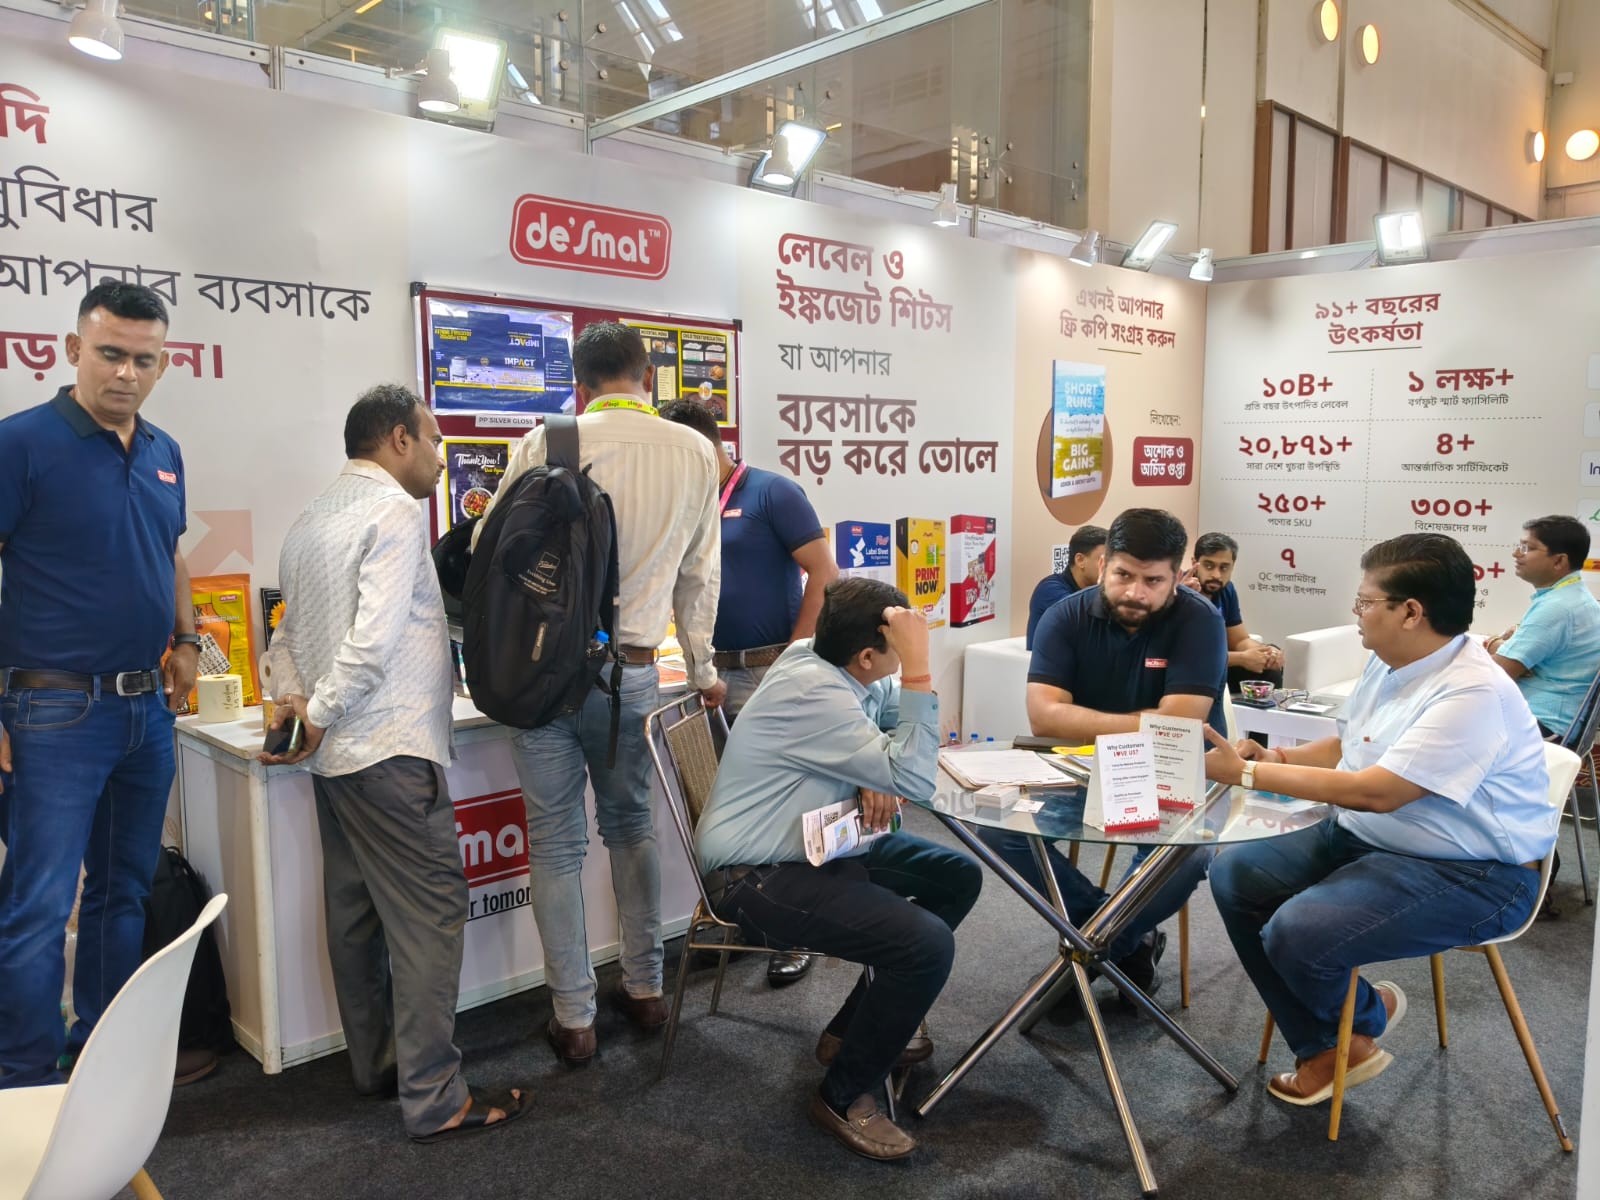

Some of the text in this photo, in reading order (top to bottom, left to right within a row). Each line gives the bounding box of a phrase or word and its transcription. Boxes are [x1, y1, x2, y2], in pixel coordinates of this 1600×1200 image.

[778, 233, 904, 279] লেবেল ও
[194, 273, 371, 321] ব্যবসাকে
[777, 269, 953, 333] ইঙ্কজেট শিটস
[1076, 286, 1164, 320] এখনই আপনার
[1315, 293, 1441, 319] ৯১+ বছরের
[1060, 309, 1176, 348] ফ্রি কপি সংগ্রহ করুন
[1327, 318, 1424, 344] উৎকর্ষতা
[504, 357, 536, 367] IMPACT
[778, 343, 892, 376] যা আপনার
[1064, 382, 1098, 396] SHORT
[1408, 368, 1514, 392] ১ লক্ষ+
[479, 416, 534, 426] PP SILVER GLOSS
[777, 394, 917, 435] ব্যবসাকে
[1070, 443, 1089, 457] BIG
[1143, 444, 1184, 459] অশোক ও
[1239, 435, 1352, 459] ২০,৮৭১+
[778, 437, 998, 485] বড় করে তোলে
[1063, 456, 1095, 472] GAINS
[1258, 493, 1326, 513] ২৫০+
[1411, 499, 1492, 517] ৩০০+
[1294, 518, 1312, 527] SKU
[1281, 548, 1296, 568] ৭
[915, 566, 940, 581] PRINT
[1259, 572, 1272, 581] QC
[915, 581, 937, 595] NOW
[1162, 725, 1191, 733] Customers
[1118, 742, 1145, 750] Customers
